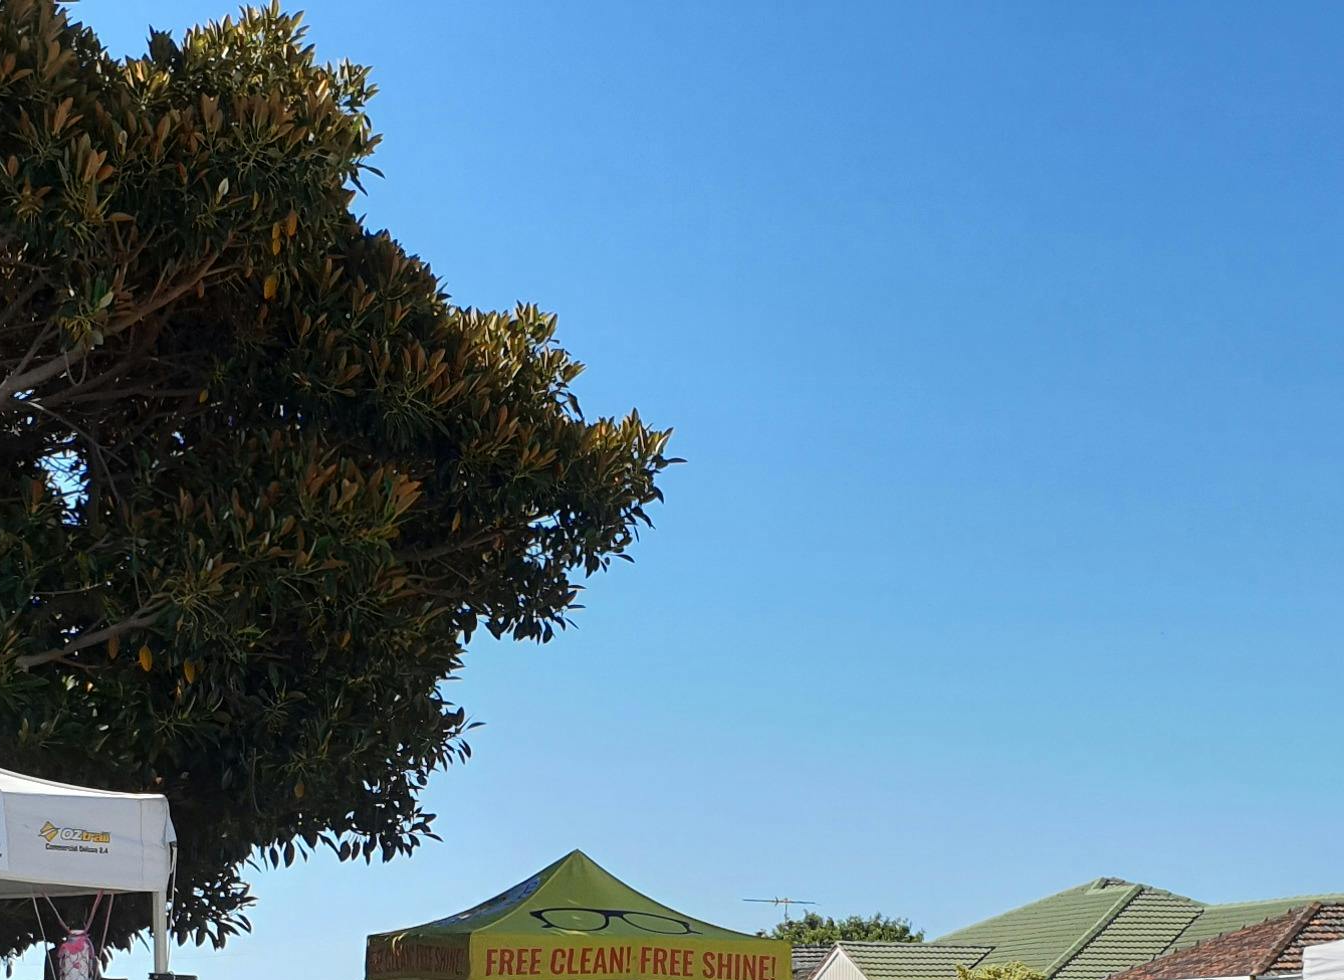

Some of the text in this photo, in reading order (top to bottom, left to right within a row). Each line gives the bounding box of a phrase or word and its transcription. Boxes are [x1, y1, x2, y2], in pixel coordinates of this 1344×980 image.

[486, 948, 541, 976] FREE
[550, 947, 631, 975] CLEAN!
[640, 947, 693, 976] FREE
